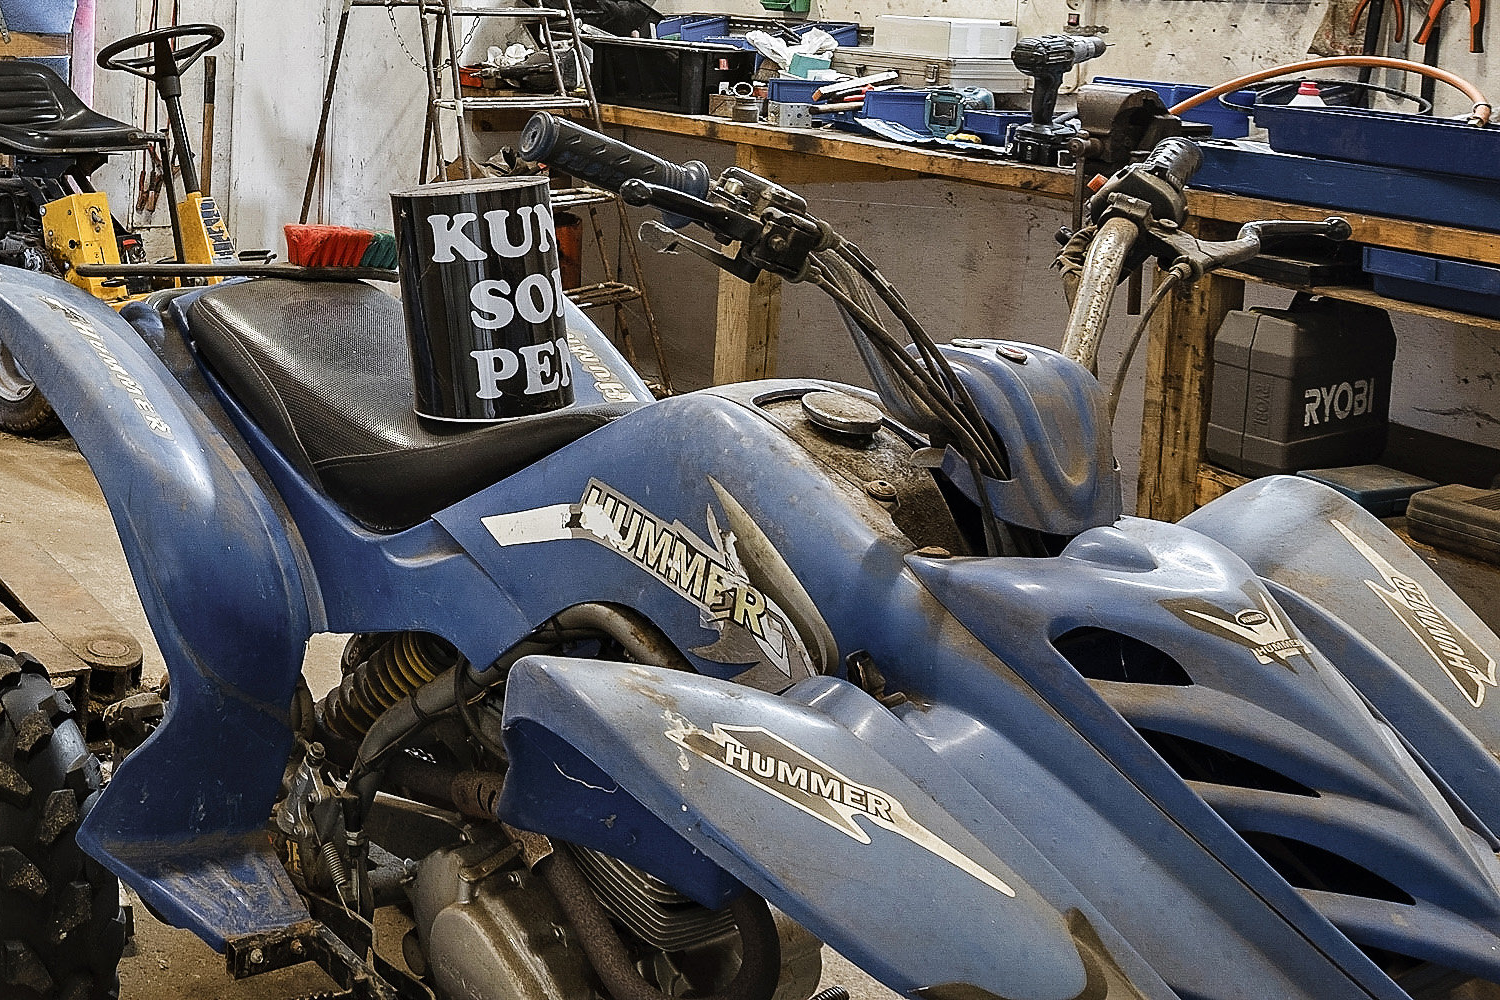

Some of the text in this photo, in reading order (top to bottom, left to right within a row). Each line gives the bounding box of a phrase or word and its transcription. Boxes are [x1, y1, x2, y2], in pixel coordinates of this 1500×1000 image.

[69, 318, 173, 436] HUMMER
[1303, 377, 1376, 427] RYOBI
[1391, 576, 1479, 675] HUMMER
[725, 741, 895, 824] HUMMER
